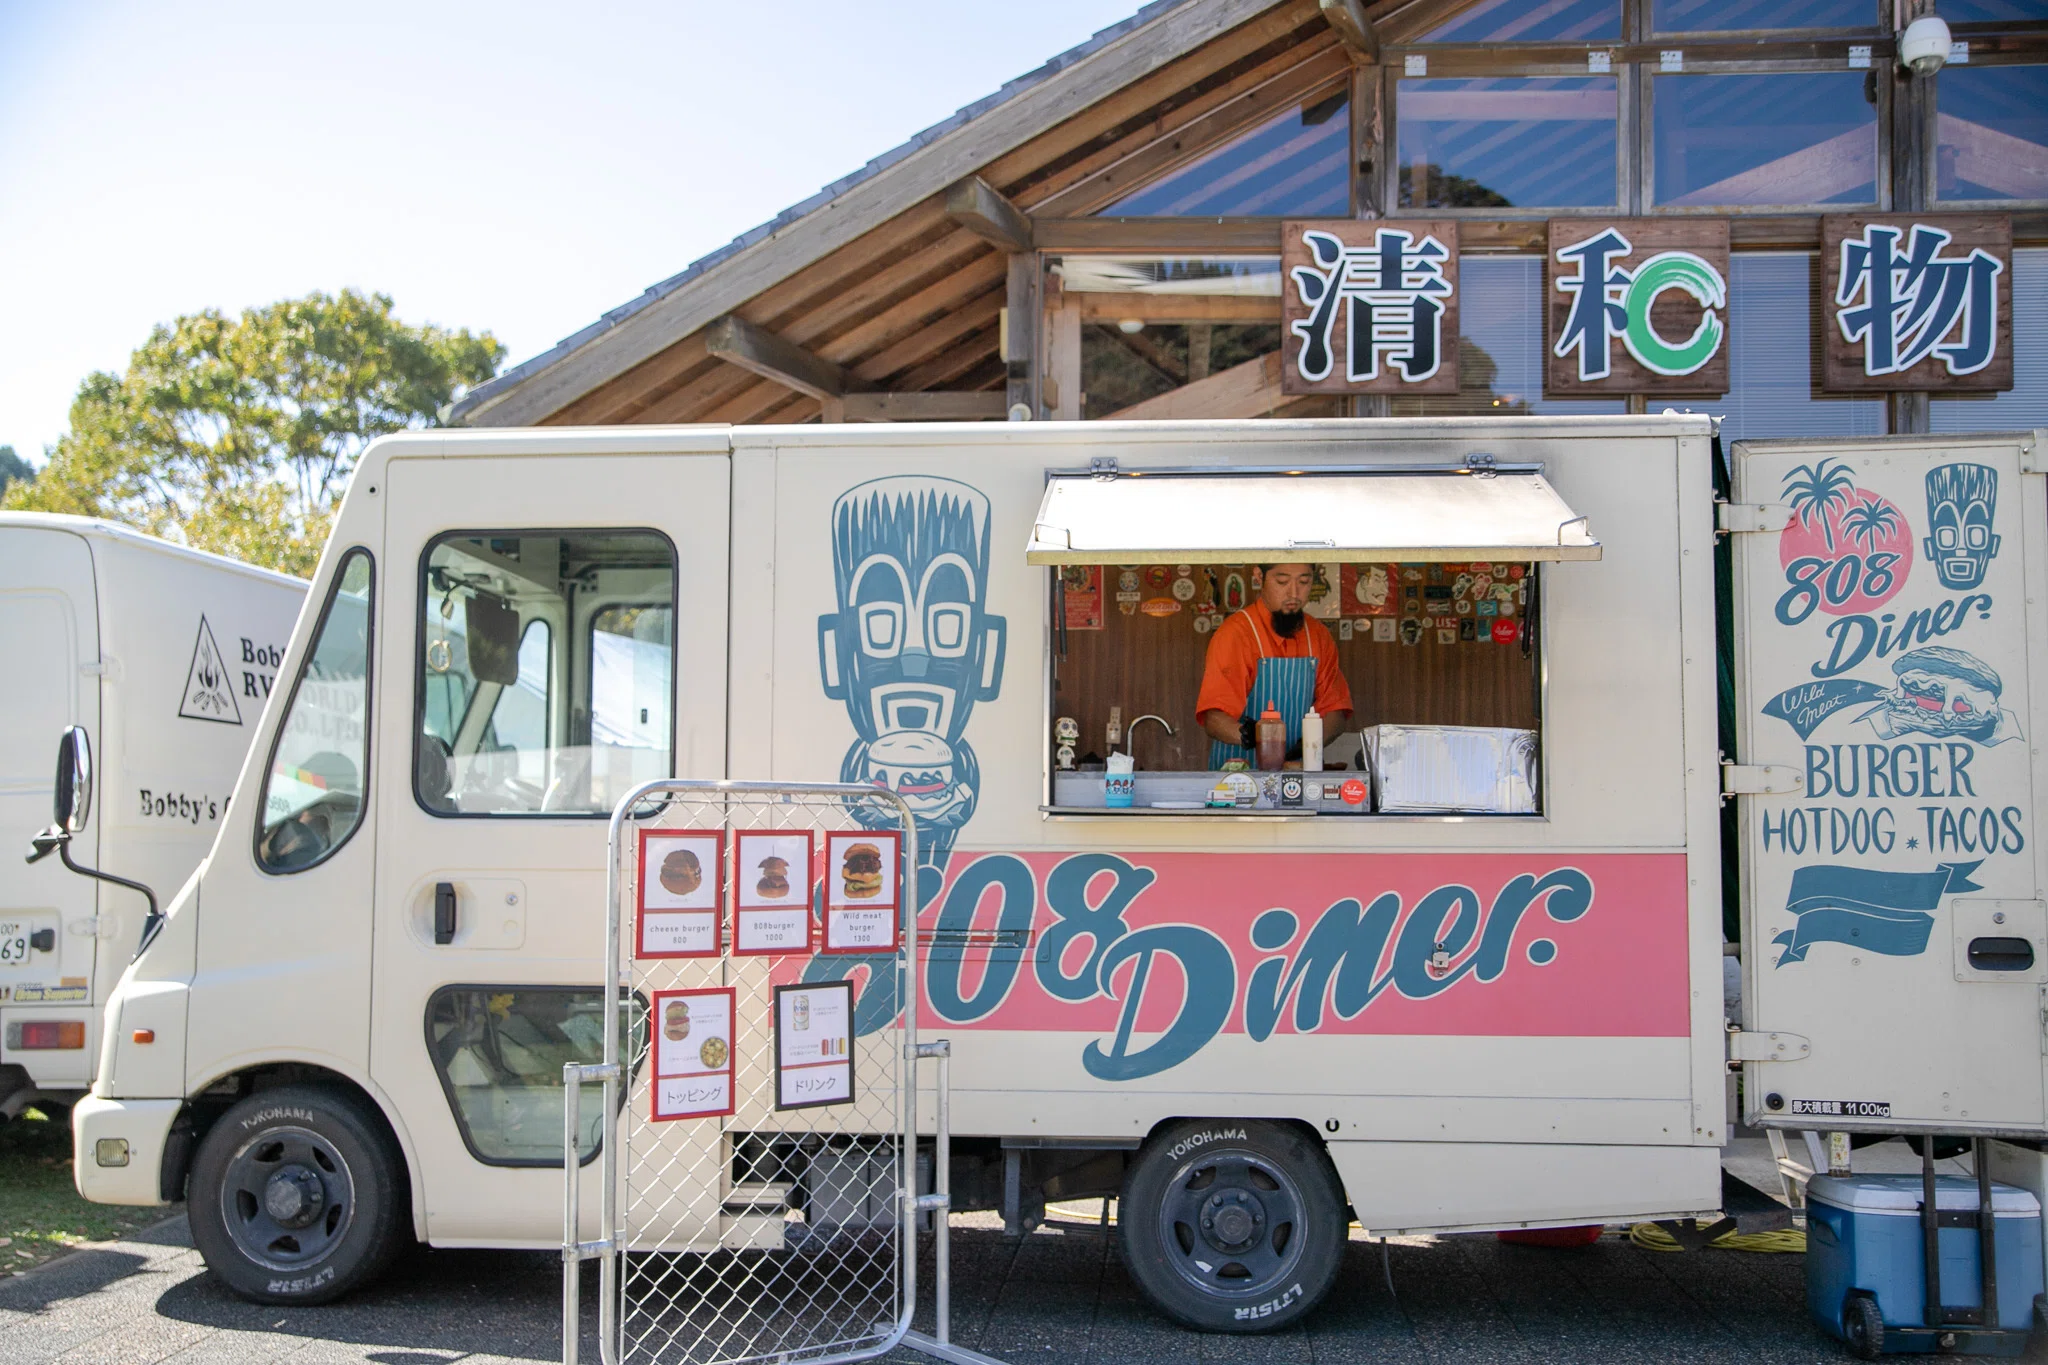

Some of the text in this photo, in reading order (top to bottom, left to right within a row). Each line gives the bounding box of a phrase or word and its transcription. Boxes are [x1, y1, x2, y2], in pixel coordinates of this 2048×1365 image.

[1774, 552, 1902, 626] 808
[303, 683, 358, 714] ORLD
[1781, 683, 1826, 714] Wild
[1802, 742, 1978, 799] BURGER
[140, 789, 217, 825] Bobby's
[1762, 806, 2025, 856] HOTDOG TACOS
[753, 922, 795, 931] 808burger
[843, 912, 859, 920] Wild
[650, 924, 710, 933] cheese burger
[849, 924, 875, 932] burger
[673, 936, 687, 944] 800
[667, 1086, 722, 1104] トッピング
[796, 1076, 836, 1093] ドリンク
[241, 1106, 314, 1129] YOKOHAMA
[1166, 1128, 1248, 1161] YOKOHAMA
